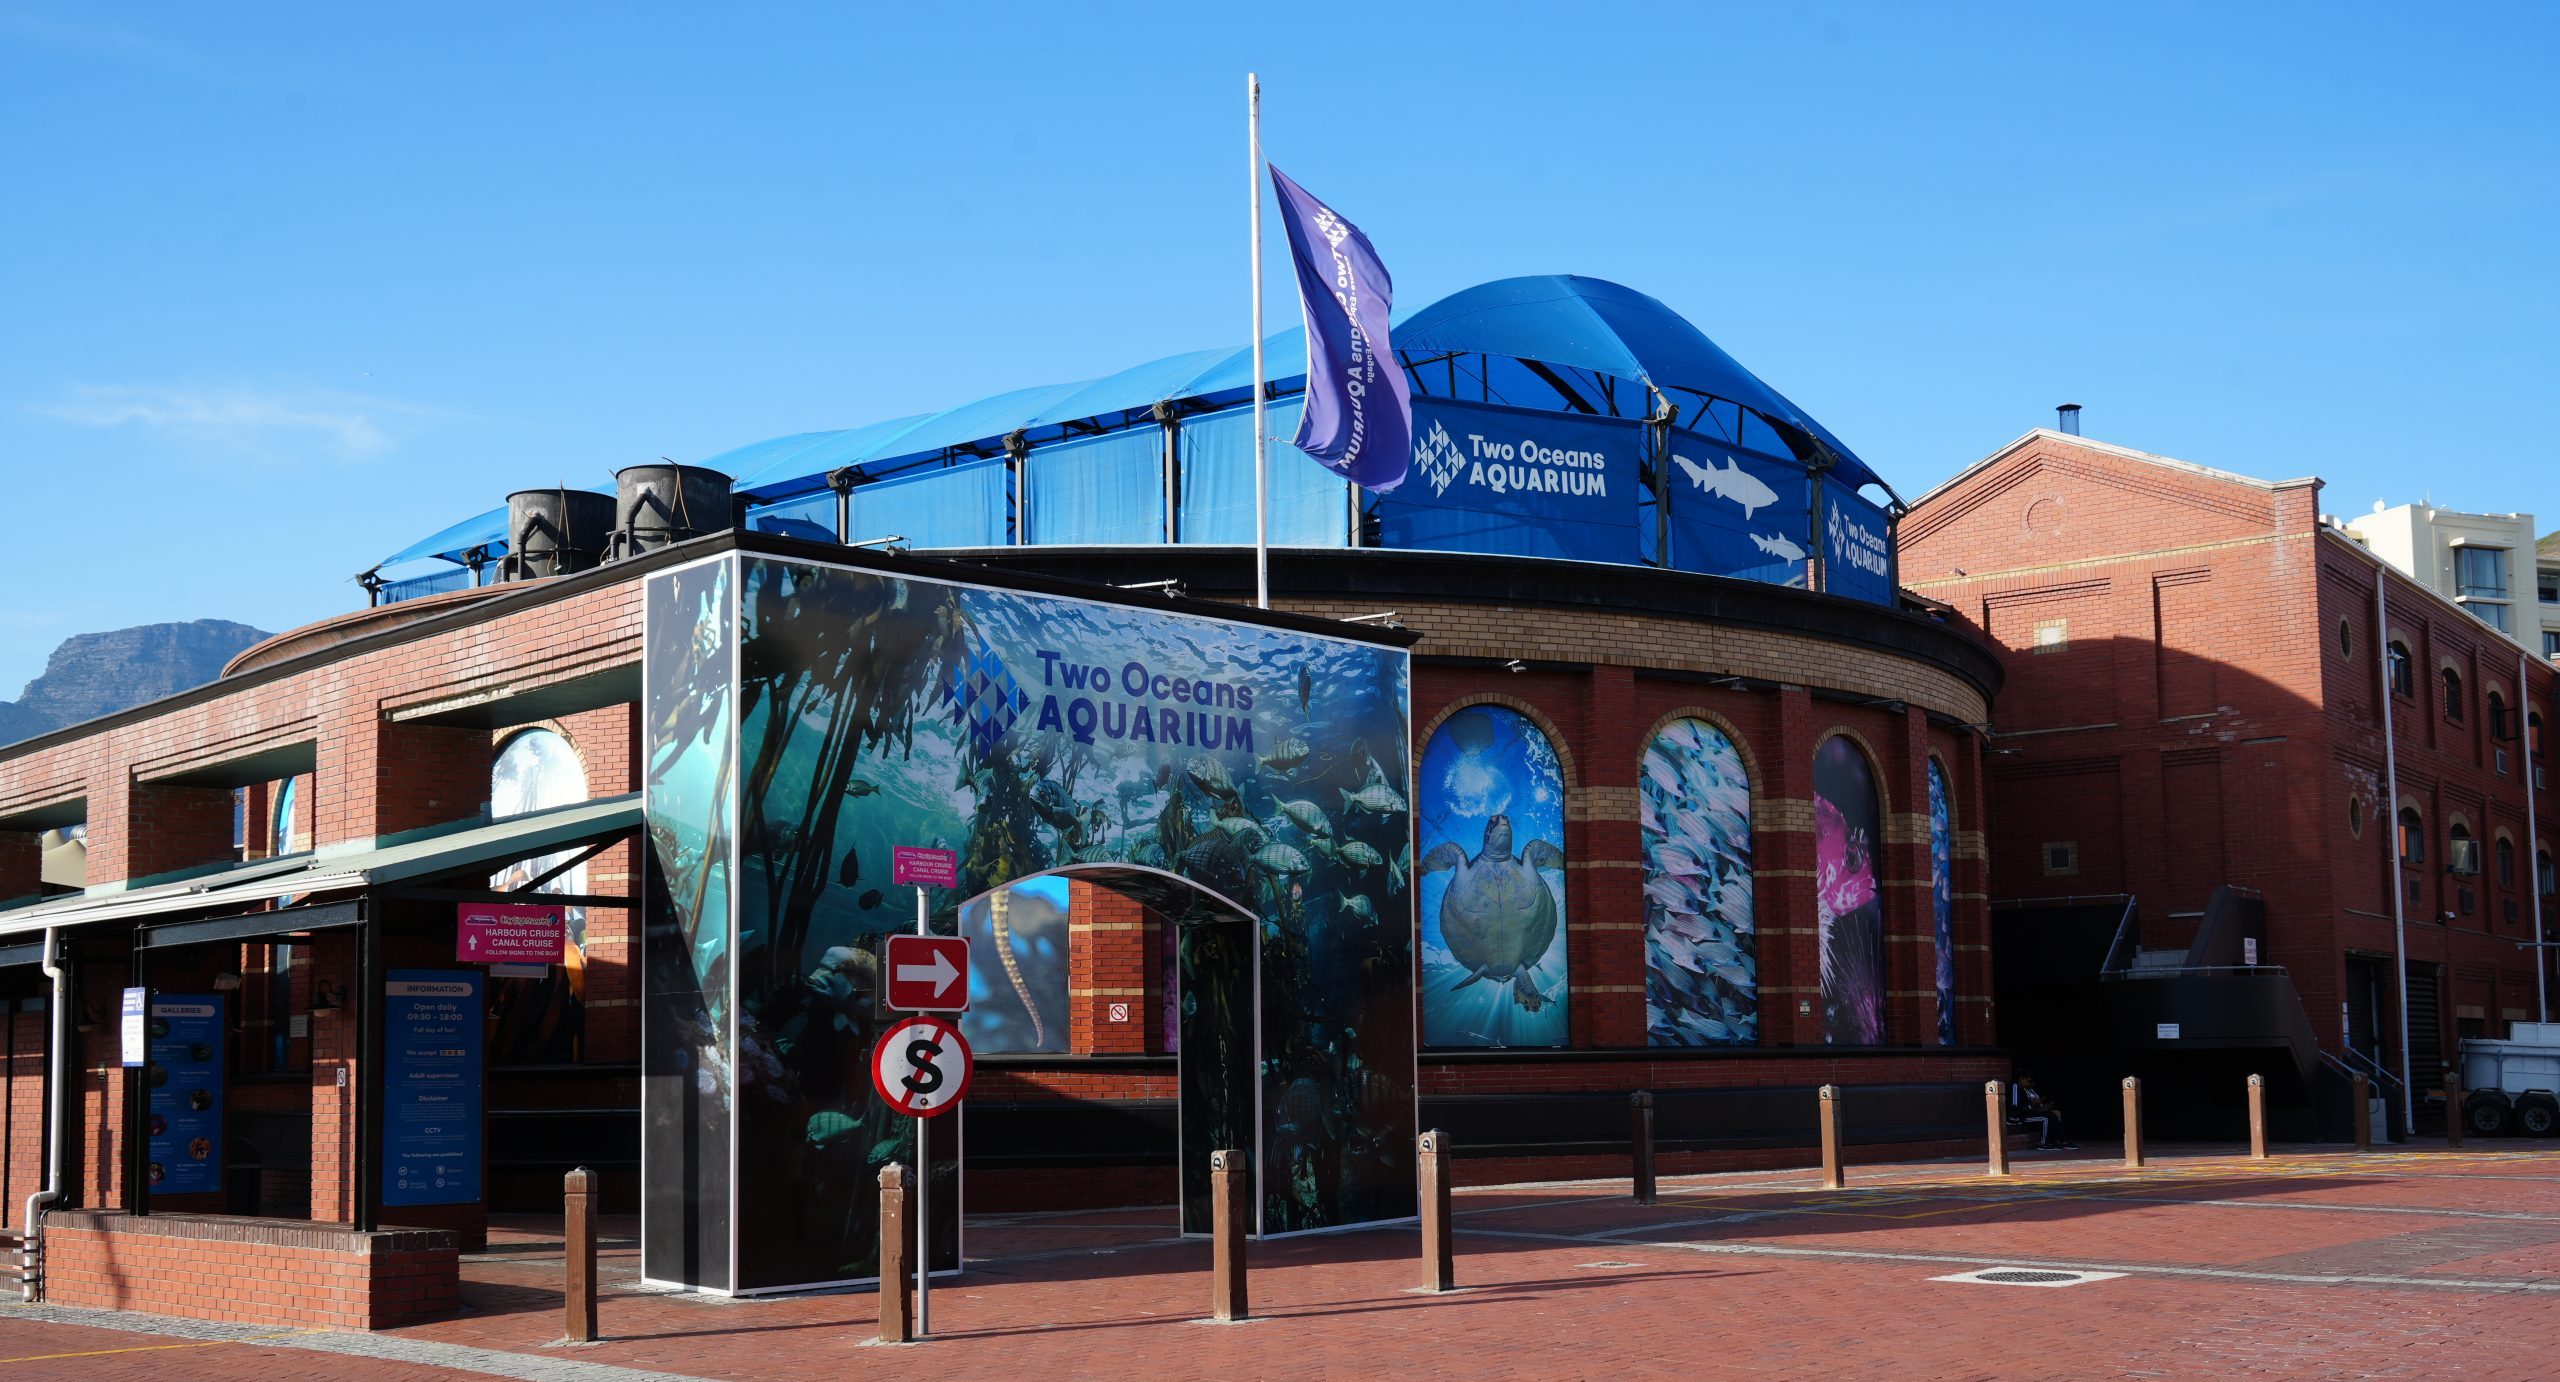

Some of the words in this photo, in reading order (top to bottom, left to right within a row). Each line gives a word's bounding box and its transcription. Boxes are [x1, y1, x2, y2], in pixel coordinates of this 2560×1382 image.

[1468, 434, 1514, 461] Two
[1520, 440, 1605, 470] Oceans
[1468, 462, 1607, 497] AQUARIUM
[1844, 514, 1858, 540] Two
[1860, 524, 1886, 555] Oceans
[1845, 538, 1888, 578] AQUARIUM
[1036, 650, 1111, 693] Two
[1122, 662, 1254, 710] Oceans
[1036, 694, 1254, 753] AQUARIUM
[414, 1004, 435, 1012] Open
[437, 1003, 457, 1012] daily
[901, 1039, 944, 1094] S
